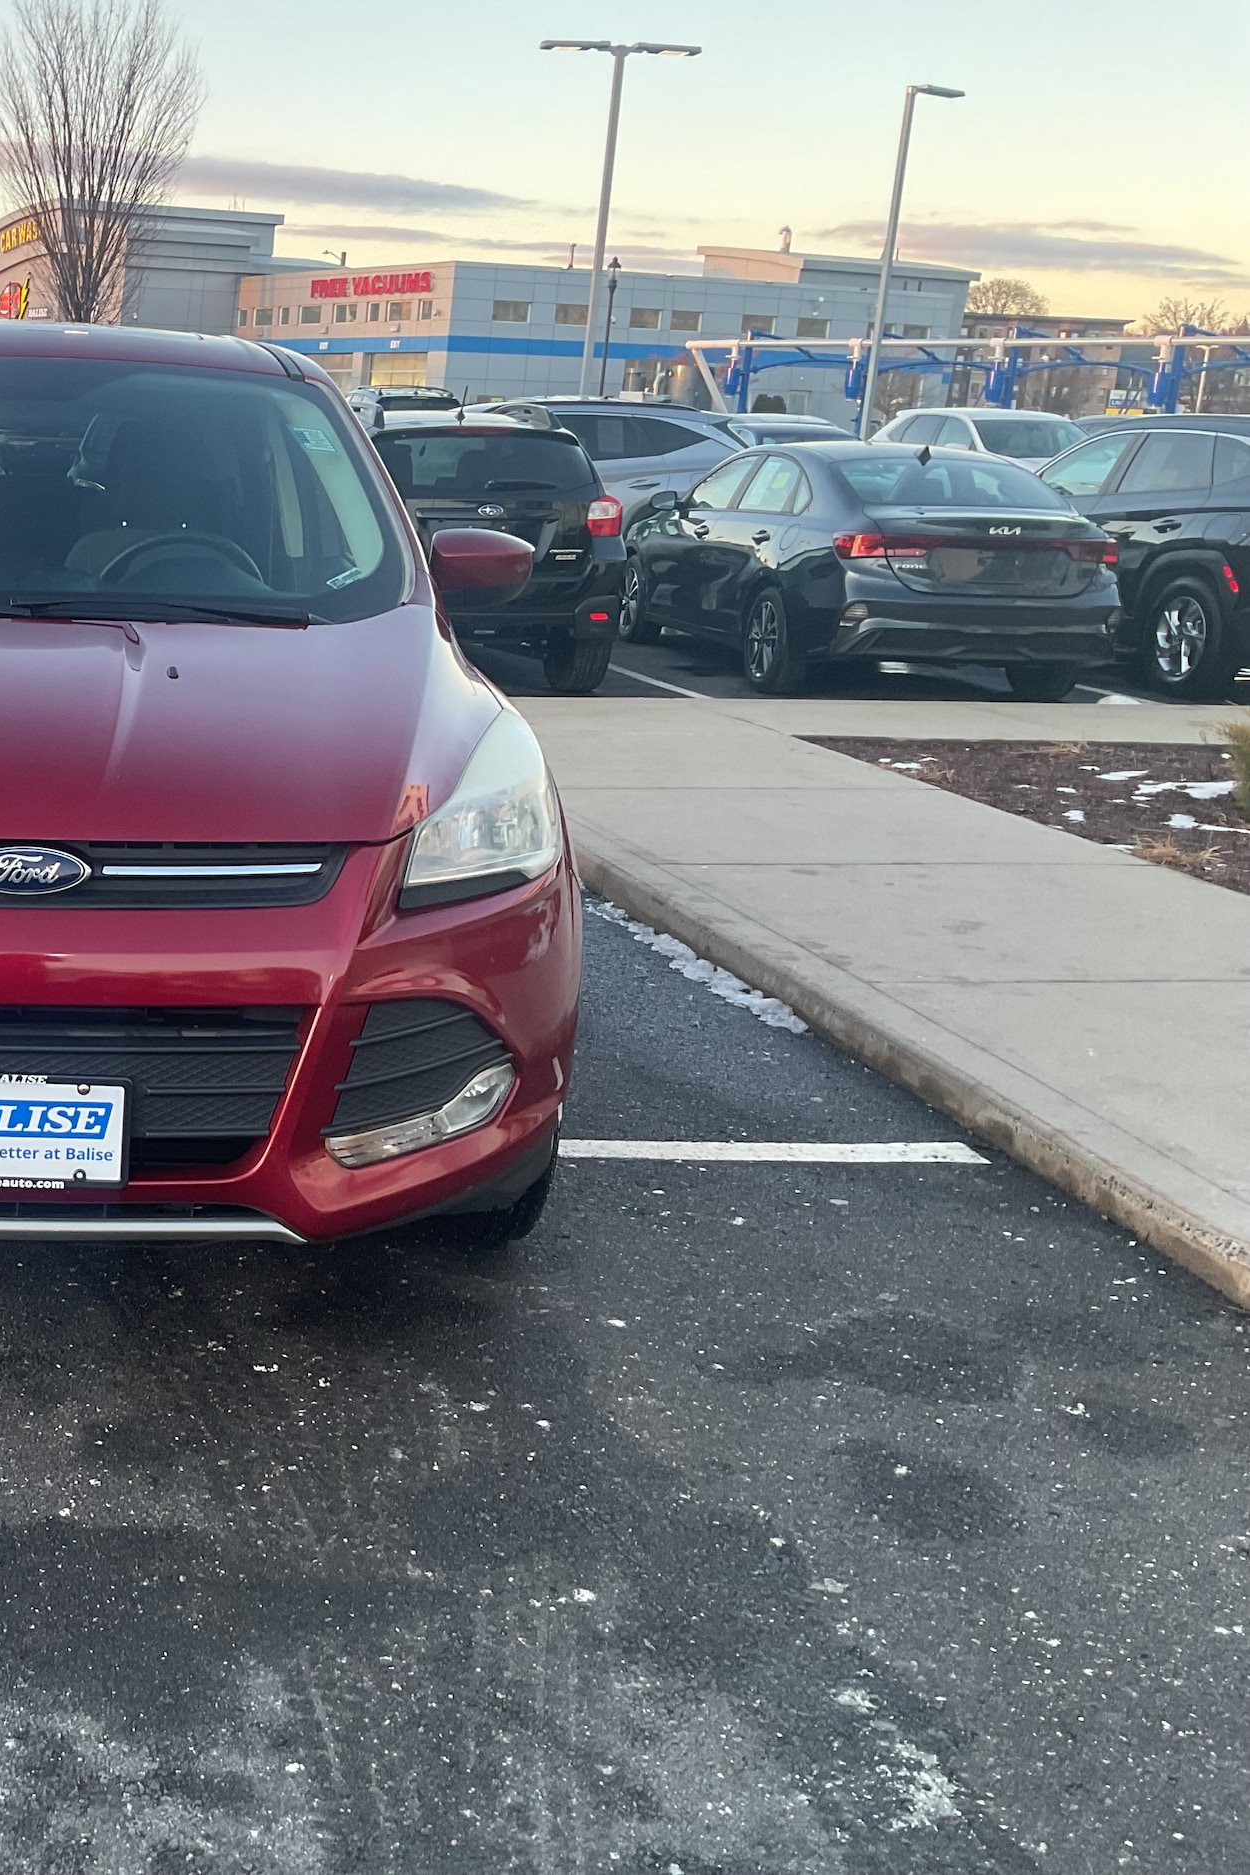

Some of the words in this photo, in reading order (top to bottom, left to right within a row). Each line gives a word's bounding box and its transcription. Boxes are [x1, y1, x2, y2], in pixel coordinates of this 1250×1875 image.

[0, 227, 17, 253] CAR
[310, 278, 349, 298] FREE
[352, 271, 433, 297] VACUUMS
[44, 1147, 60, 1160] at
[66, 1147, 113, 1161] Balise
